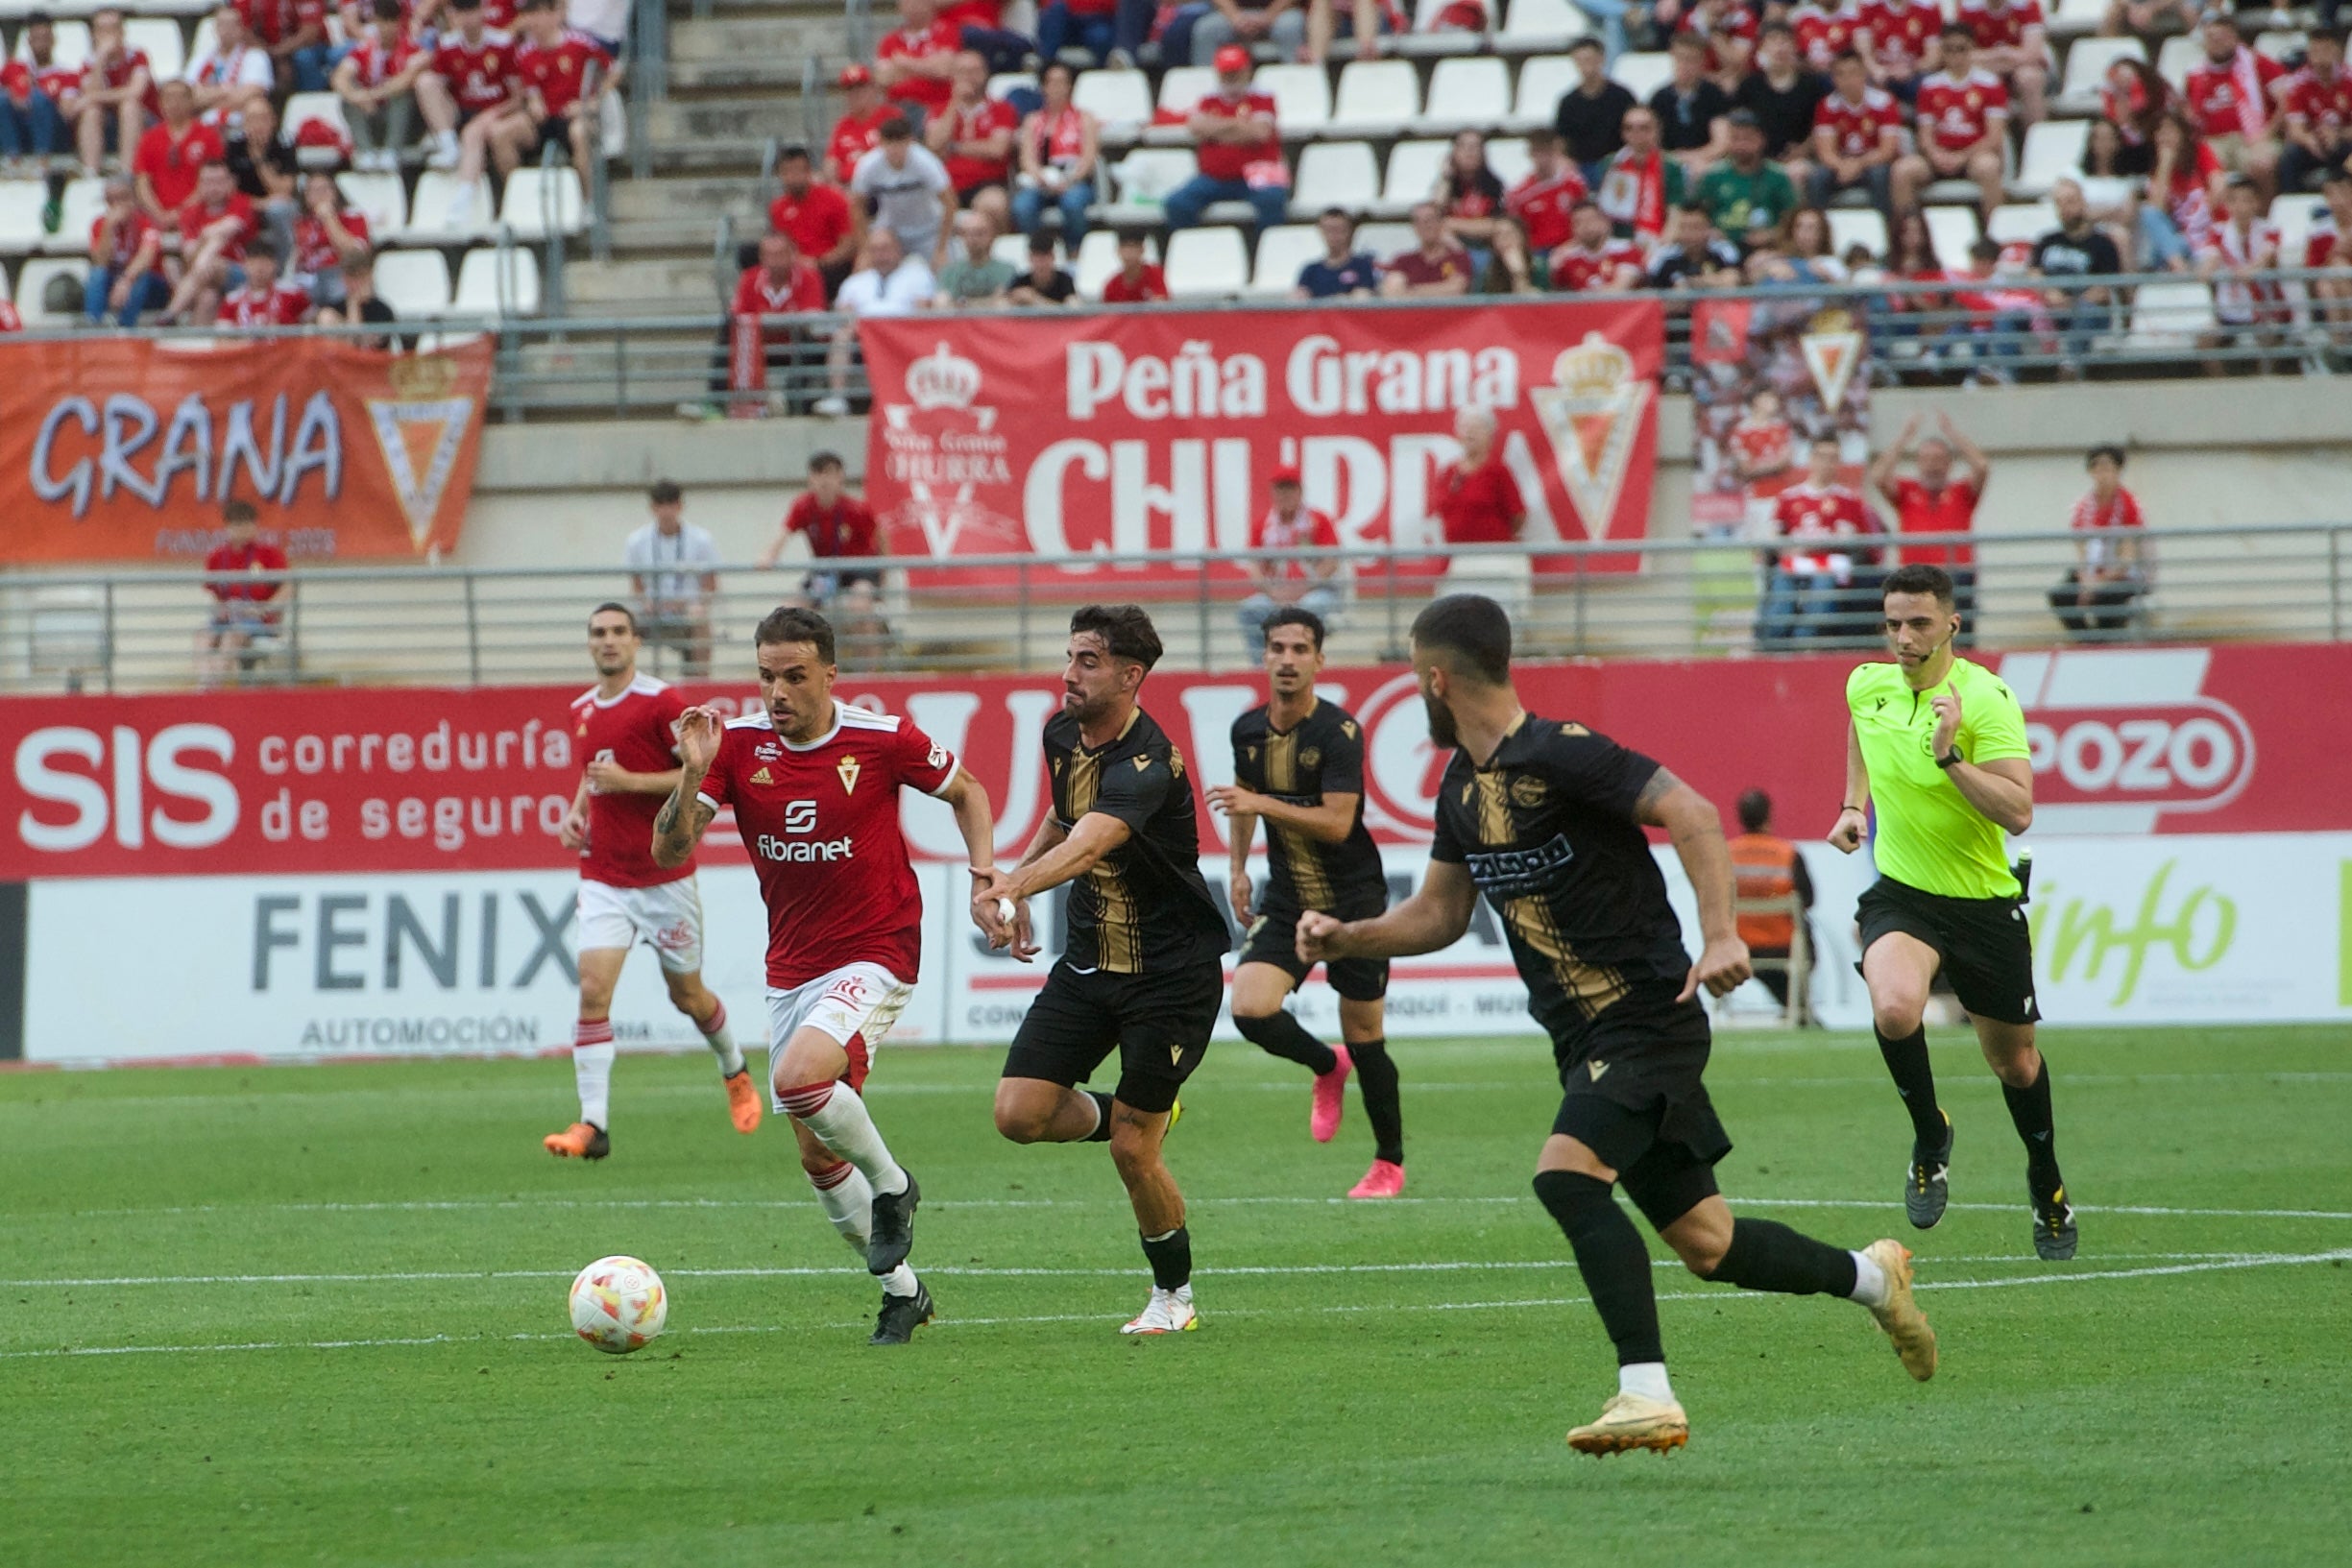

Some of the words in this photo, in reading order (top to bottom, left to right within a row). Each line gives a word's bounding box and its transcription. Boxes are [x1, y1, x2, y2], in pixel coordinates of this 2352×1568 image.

[1066, 339, 1268, 420] Peña
[1287, 334, 1520, 417] Grana
[29, 391, 344, 519] GRANA
[14, 722, 241, 853] SIS
[259, 718, 572, 774] correduría
[260, 787, 328, 841] de
[362, 793, 572, 850] seguro
[757, 833, 853, 862] fibranet
[252, 891, 579, 991] FENIX
[2028, 856, 2239, 1009] info
[301, 1015, 539, 1049] AUTOMOCIÓN
